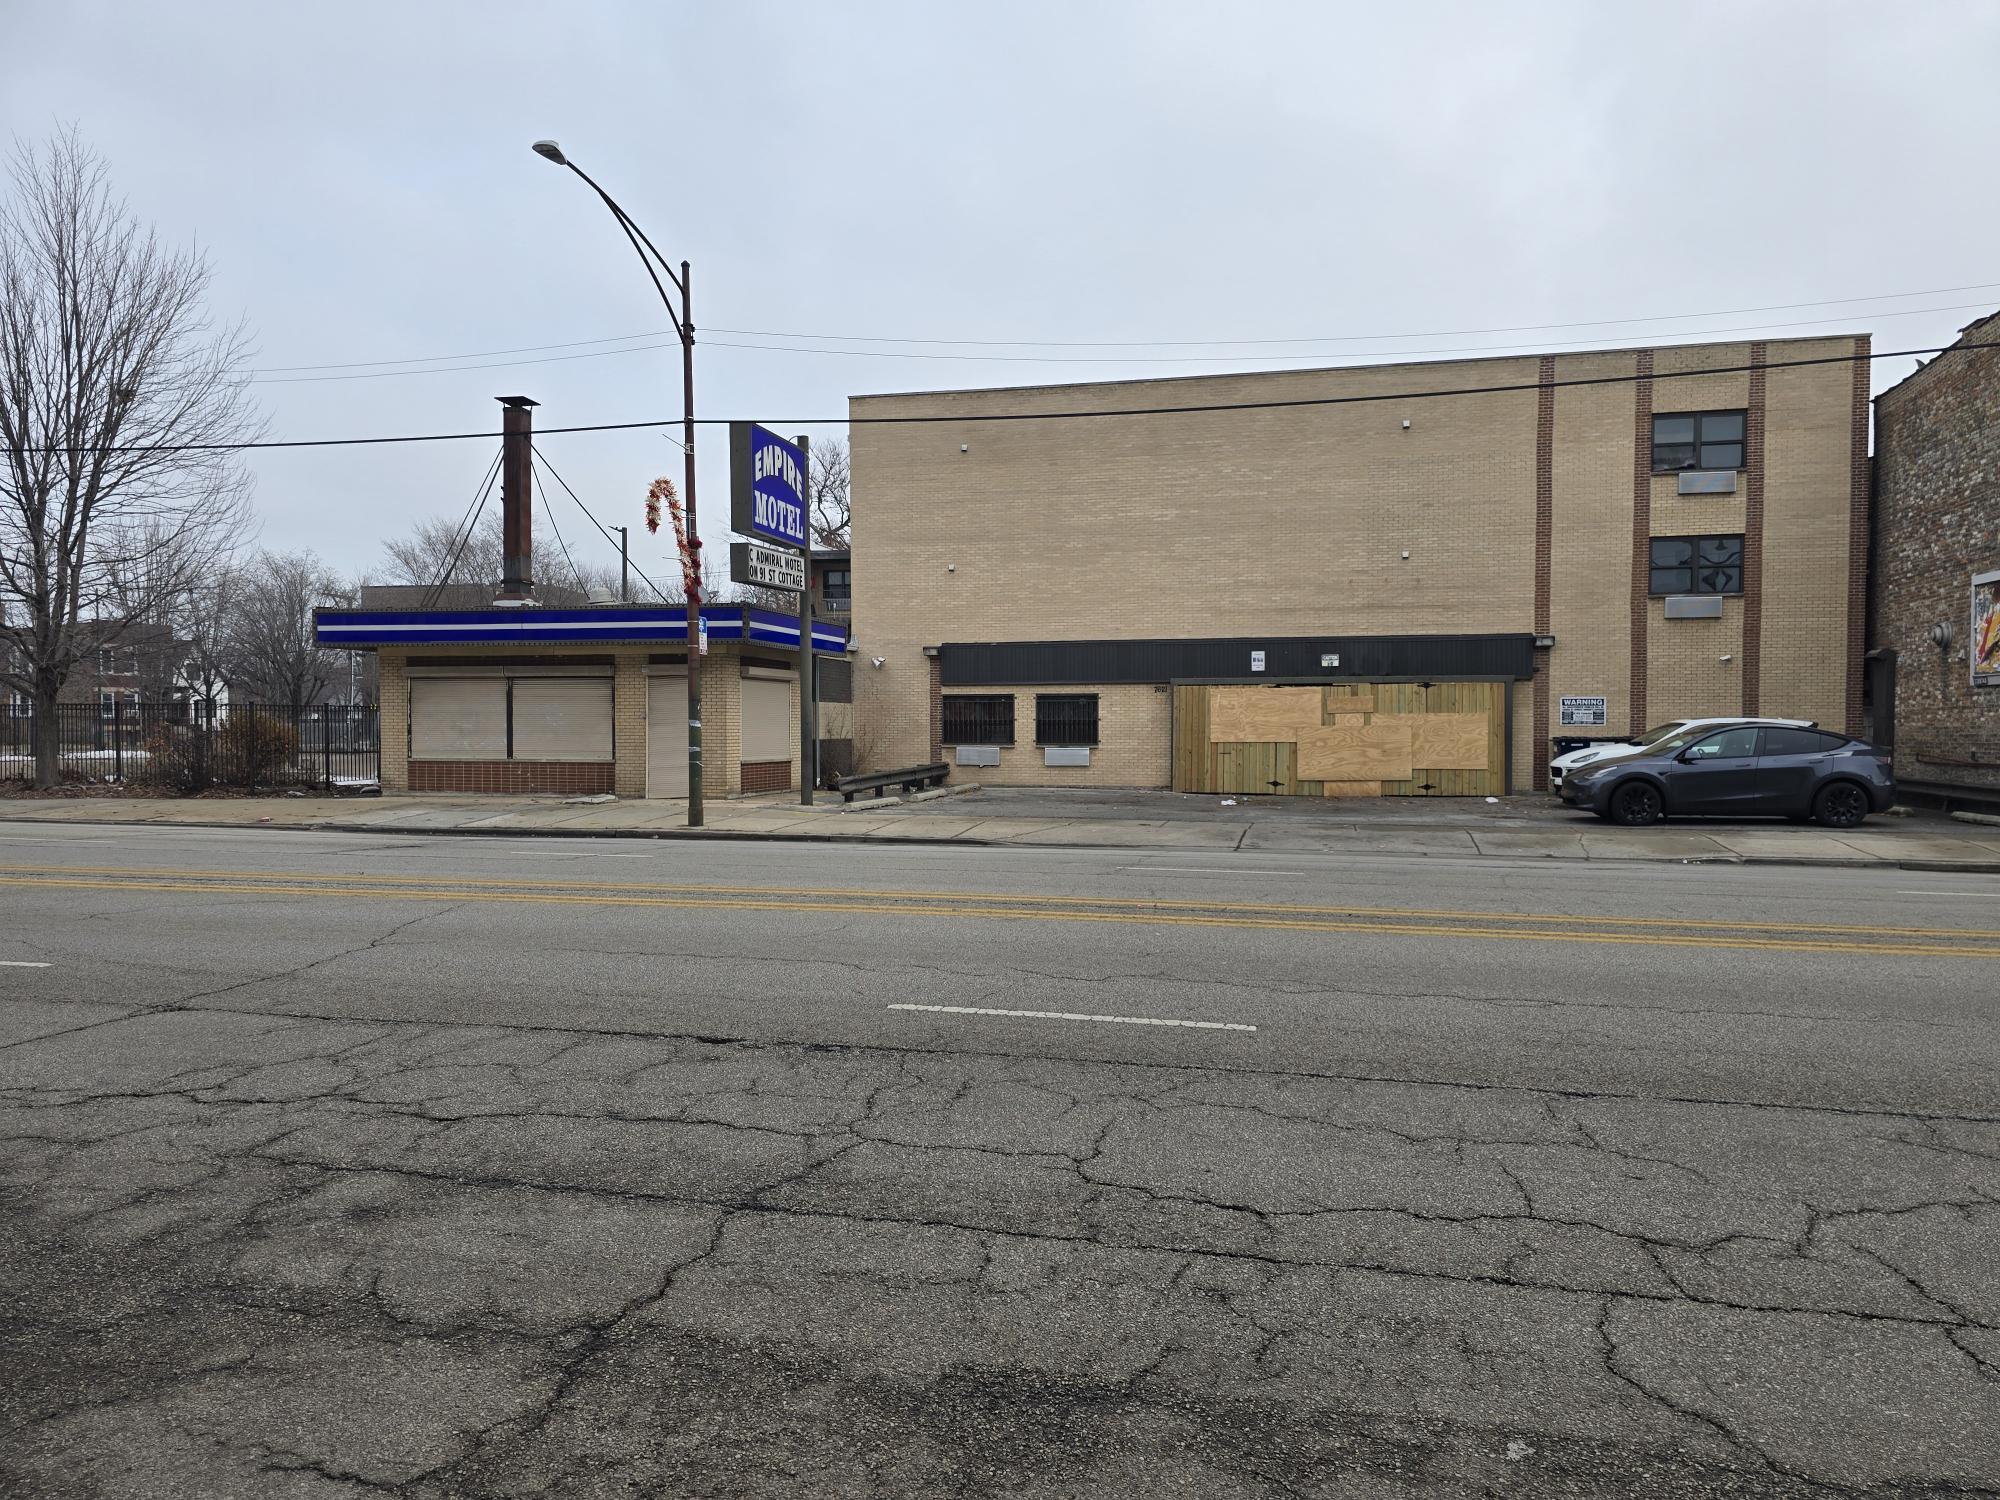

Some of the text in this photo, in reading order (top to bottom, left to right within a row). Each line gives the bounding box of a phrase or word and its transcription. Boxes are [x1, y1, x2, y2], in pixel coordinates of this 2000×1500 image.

[755, 444, 803, 502] EMPIRE
[754, 489, 804, 540] MOTEL
[749, 564, 803, 588] ON 91 ST COTTAGE
[756, 550, 783, 568] ADMIRAL
[785, 556, 804, 573] MOTEL
